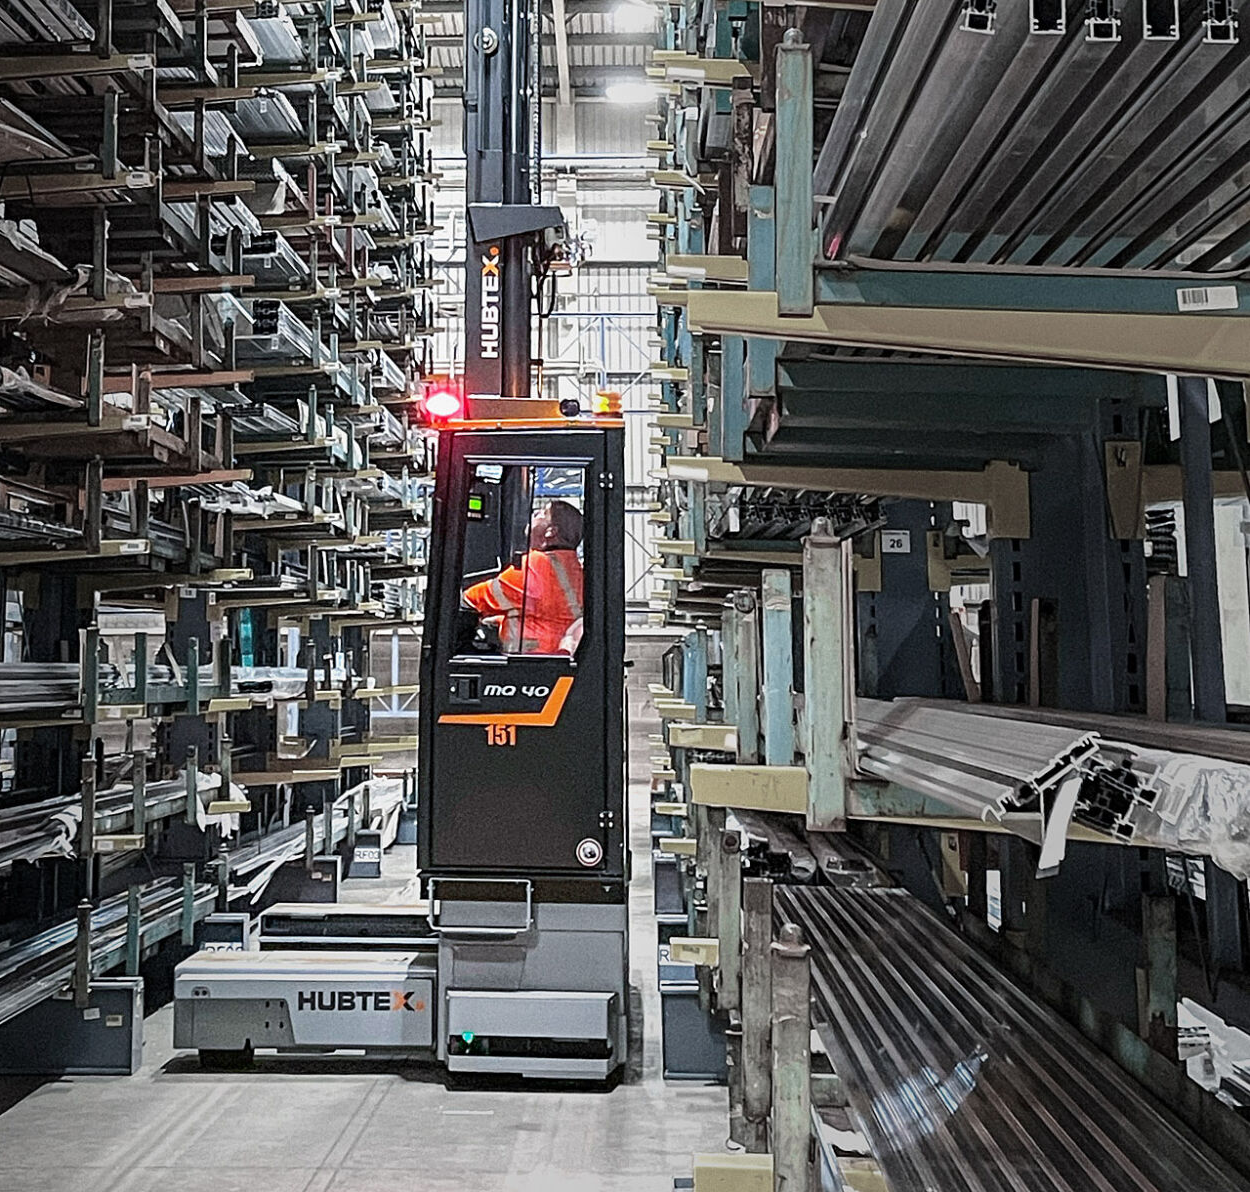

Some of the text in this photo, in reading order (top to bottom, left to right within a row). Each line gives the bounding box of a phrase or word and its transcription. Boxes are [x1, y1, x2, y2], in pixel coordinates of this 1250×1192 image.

[481, 254, 499, 358] HUBTEX
[889, 539, 903, 548] 26
[521, 685, 550, 697] 40
[484, 724, 517, 746] 151
[298, 991, 415, 1012] HUBTEX
